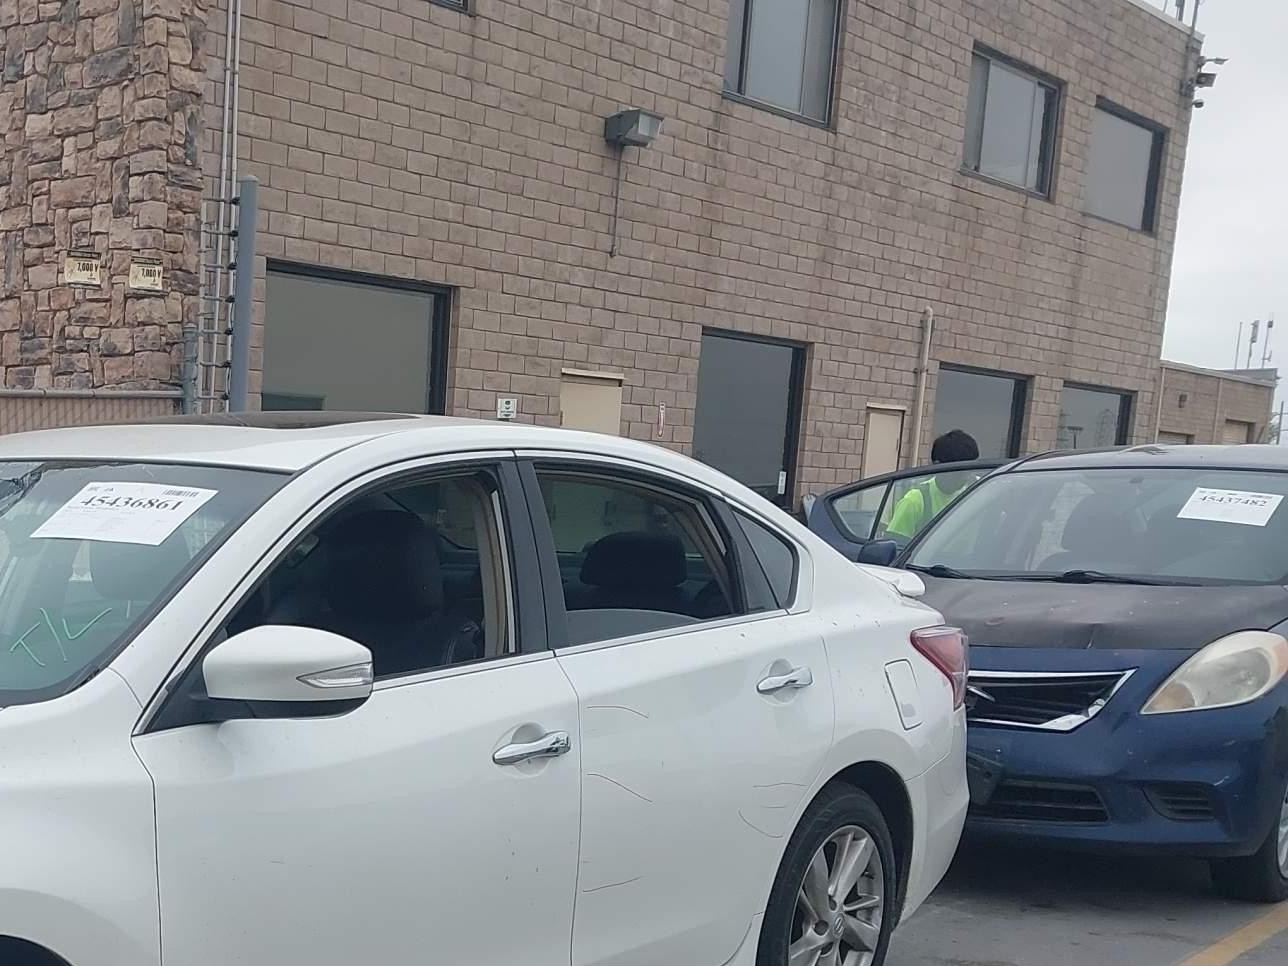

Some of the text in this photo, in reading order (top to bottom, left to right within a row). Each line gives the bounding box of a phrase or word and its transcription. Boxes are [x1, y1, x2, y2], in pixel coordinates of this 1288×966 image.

[77, 262, 99, 273] 7,000 V
[80, 495, 184, 511] 45436861
[1199, 494, 1268, 507] 45437482
